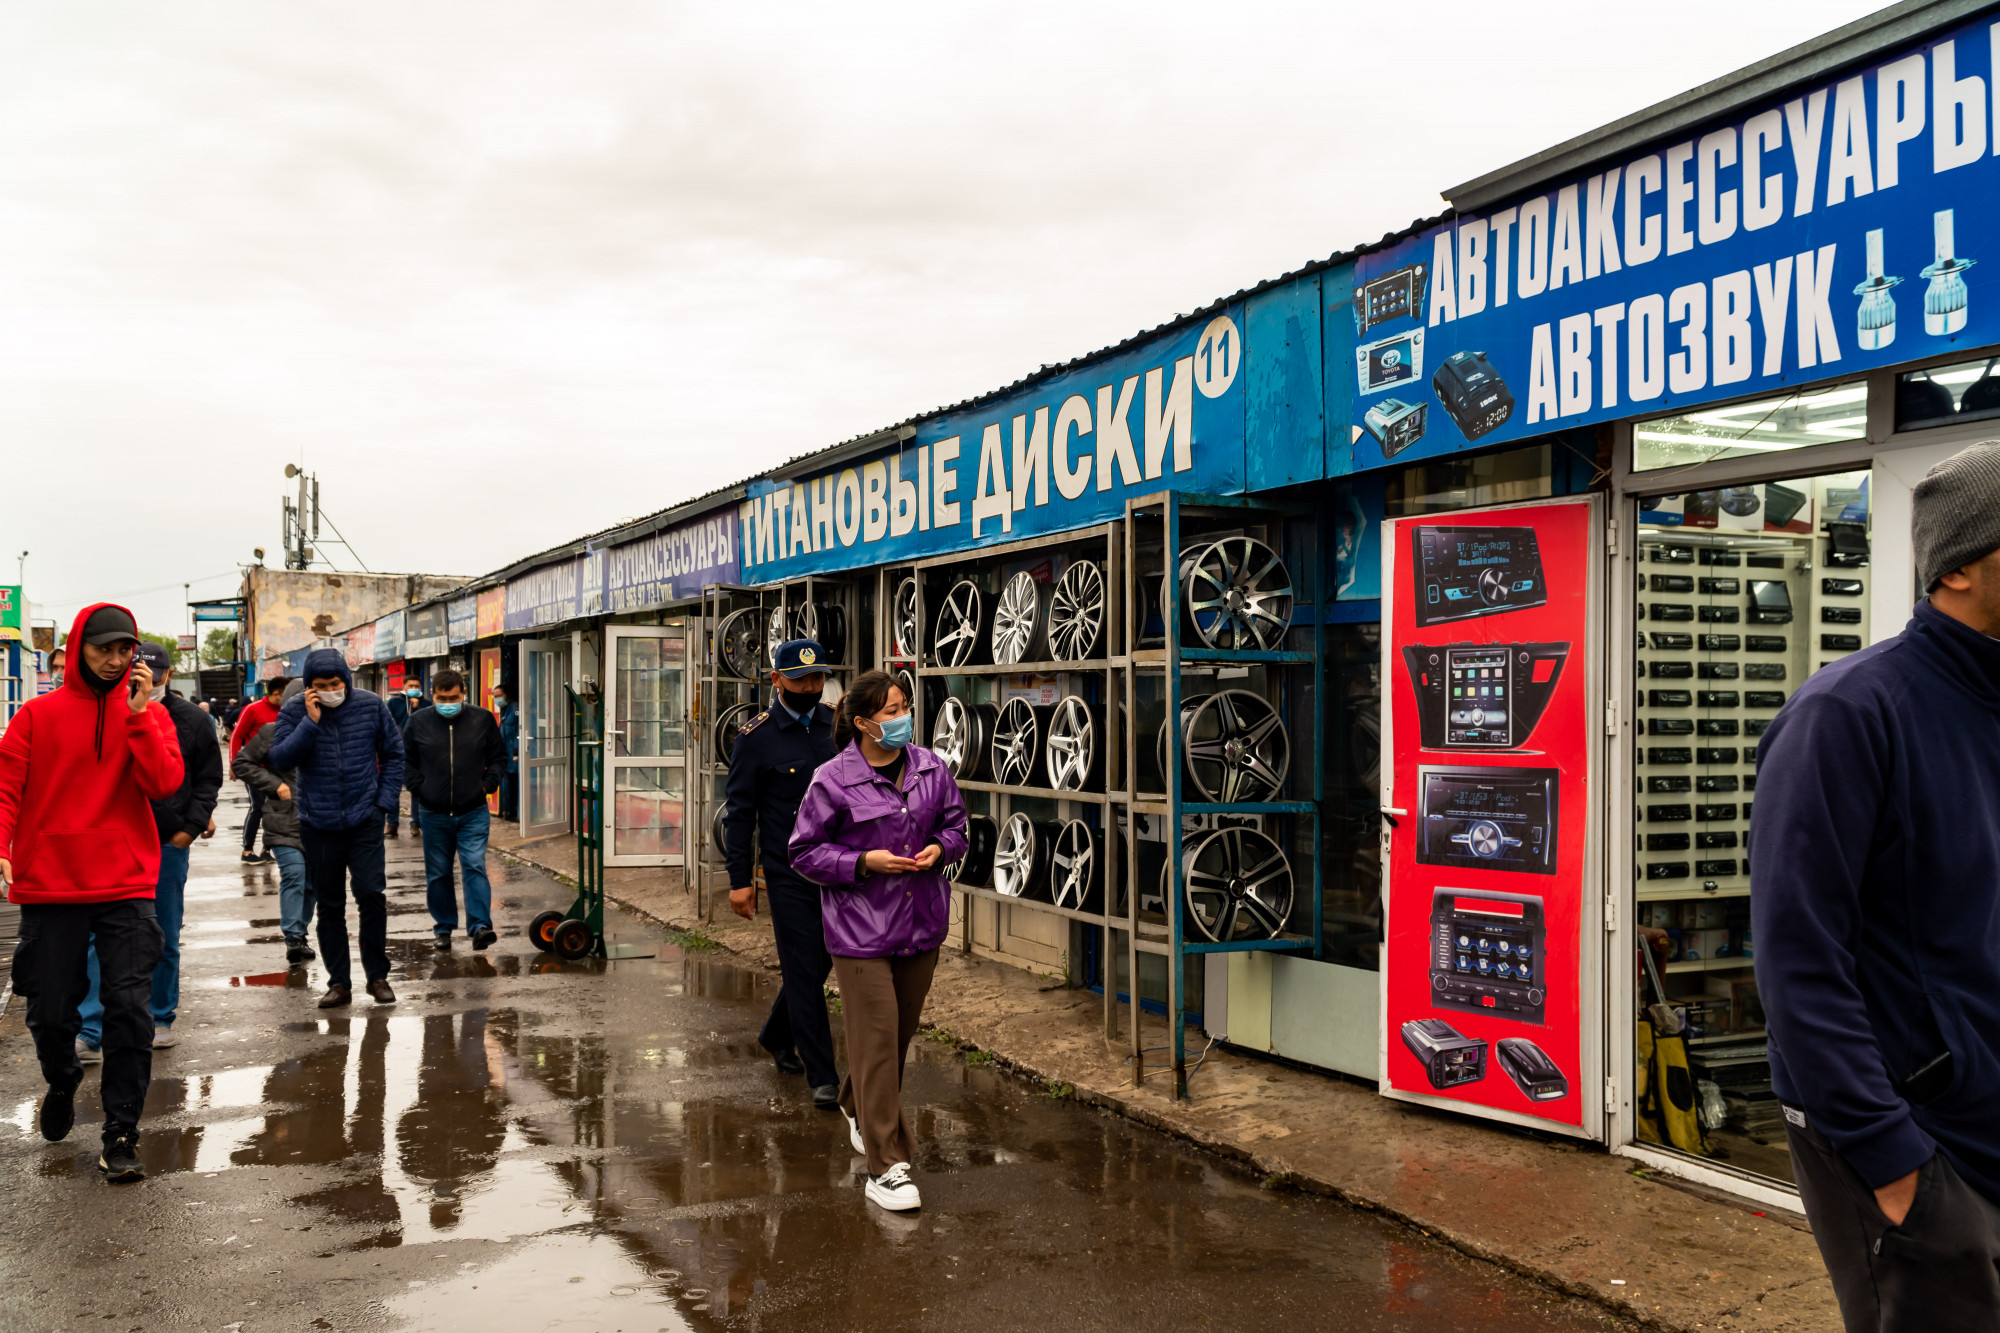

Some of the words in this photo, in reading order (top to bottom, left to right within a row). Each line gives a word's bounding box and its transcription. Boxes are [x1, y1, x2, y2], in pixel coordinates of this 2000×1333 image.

[1427, 22, 2000, 329] АВТОАКСЕССУАРЫ
[1199, 329, 1231, 385] 11
[1527, 243, 1842, 425] АВТОЗВУК
[1381, 366, 1401, 376] TOYOTA
[1486, 405, 1508, 427] 12:00
[739, 434, 961, 568] ТИТАНОВЫЕ
[972, 355, 1195, 540] ДИСКИ
[608, 514, 735, 590] АВТОАКСЕССУАРЫ
[236, 607, 244, 616] 2
